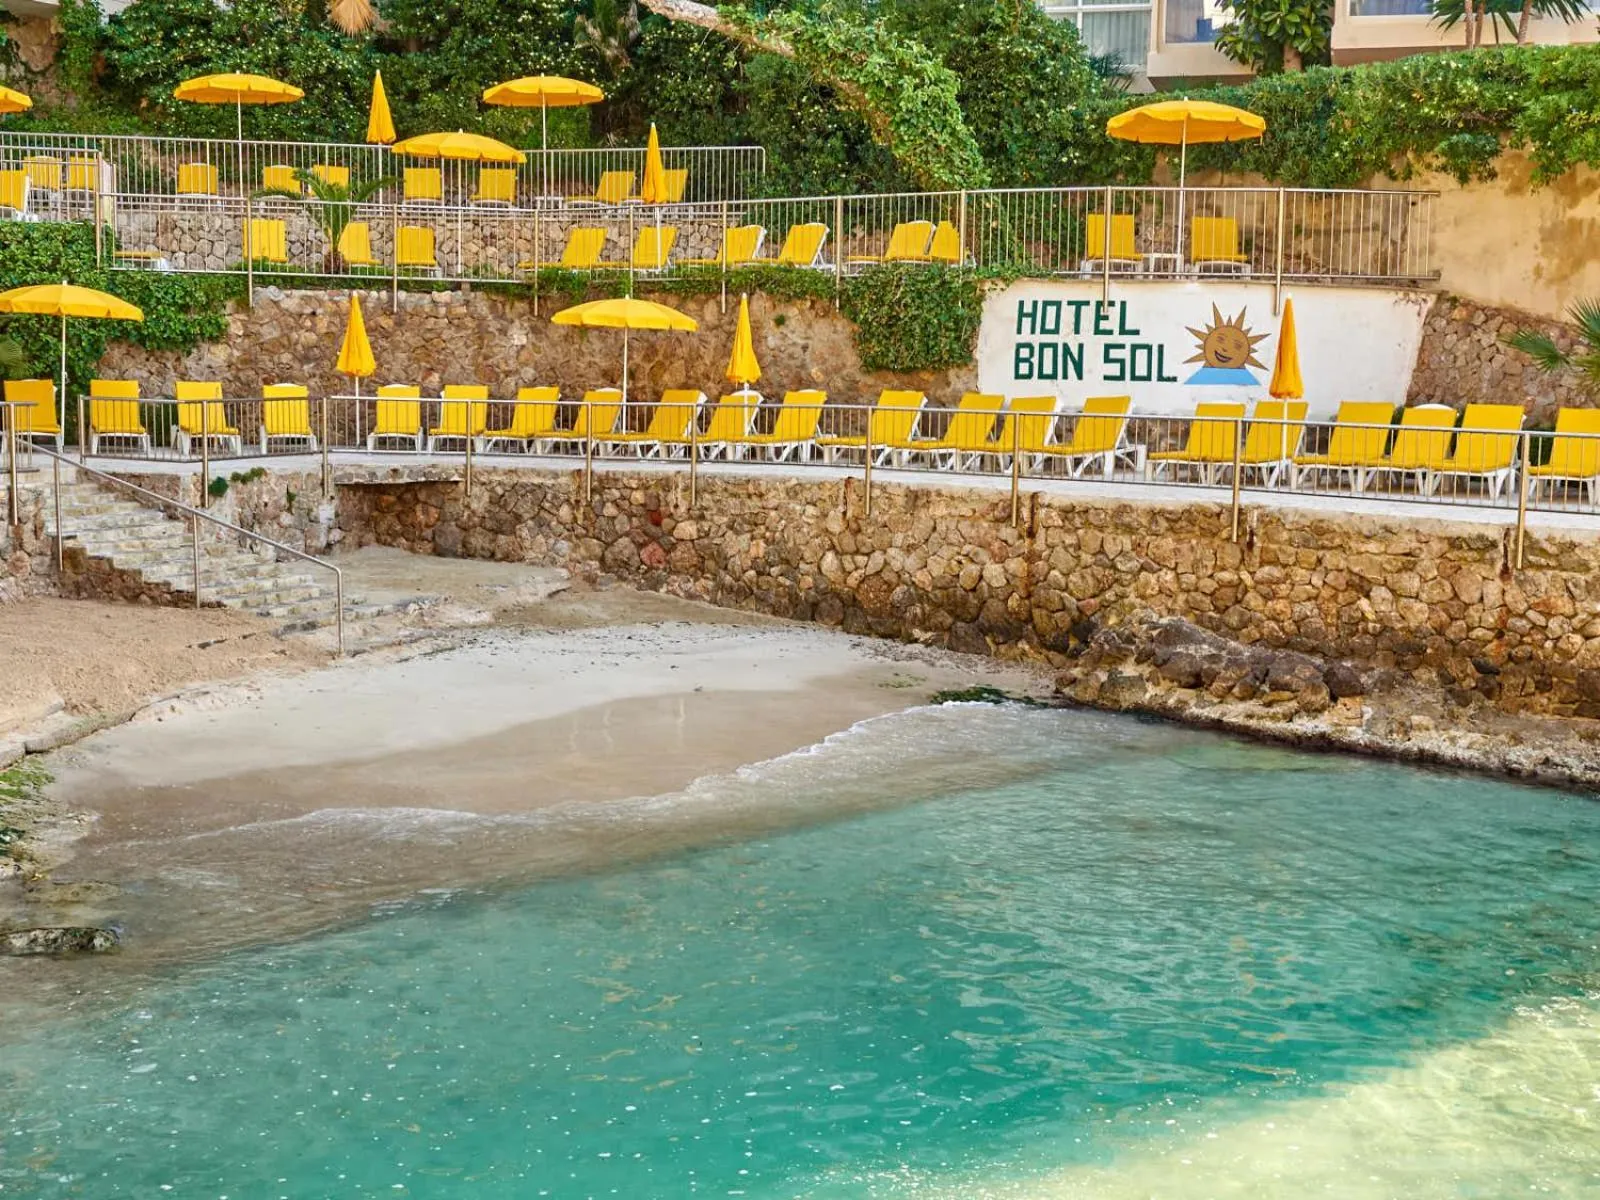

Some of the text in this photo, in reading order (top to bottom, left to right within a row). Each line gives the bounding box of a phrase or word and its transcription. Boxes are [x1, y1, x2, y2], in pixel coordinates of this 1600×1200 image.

[1016, 299, 1141, 336] HOTEL
[1014, 342, 1178, 383] BON SOL
